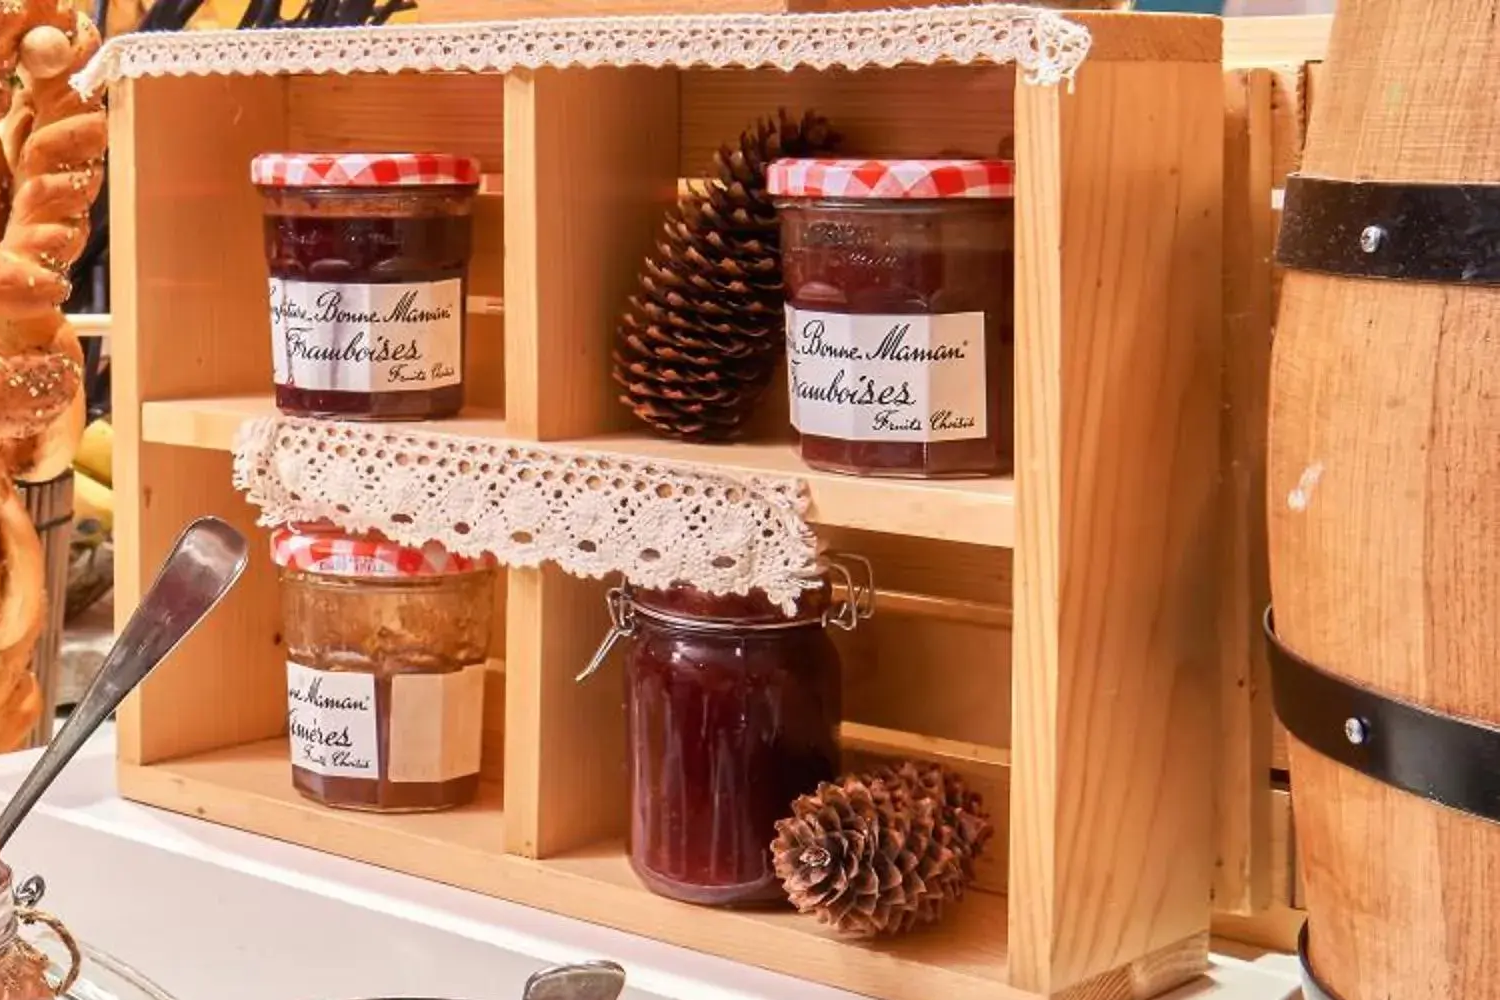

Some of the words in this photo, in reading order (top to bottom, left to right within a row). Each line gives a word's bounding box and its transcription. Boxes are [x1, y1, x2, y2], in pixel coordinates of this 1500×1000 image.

[313, 290, 380, 323] Bonne
[286, 327, 422, 362] Framboises
[801, 320, 862, 359] Bonne
[872, 409, 922, 431] Fruits
